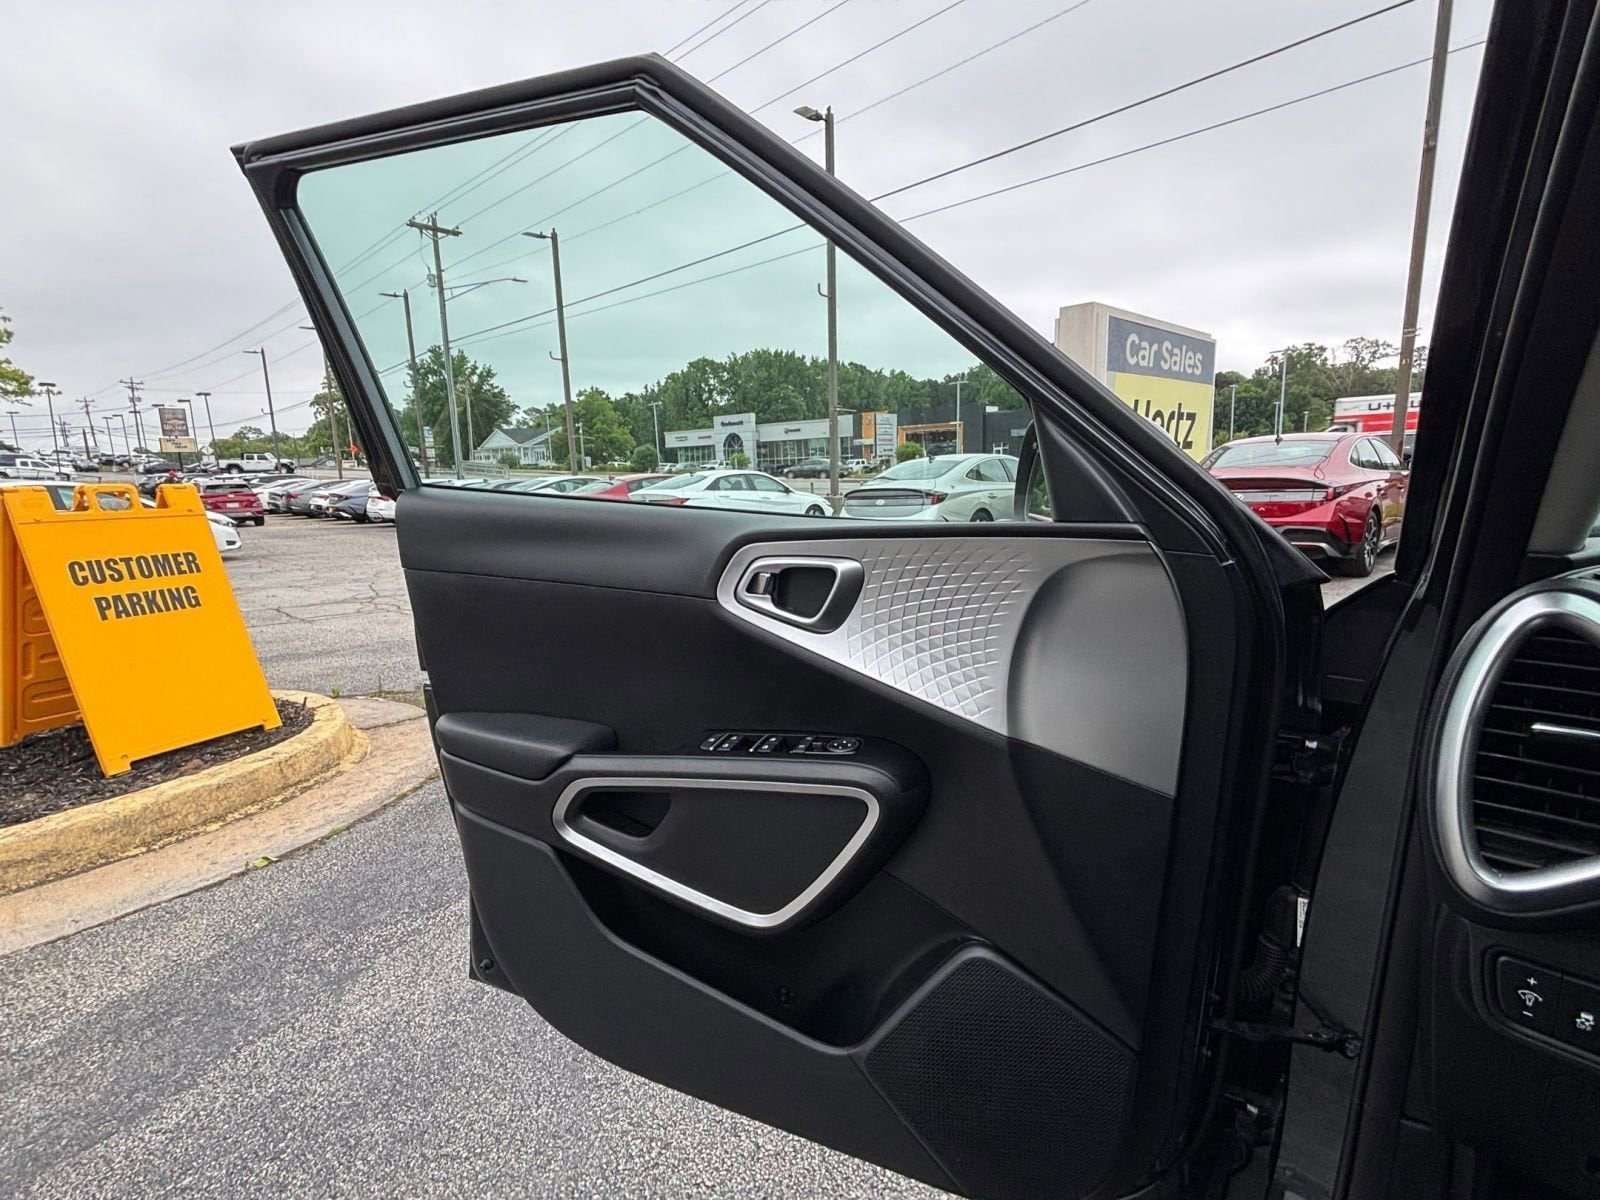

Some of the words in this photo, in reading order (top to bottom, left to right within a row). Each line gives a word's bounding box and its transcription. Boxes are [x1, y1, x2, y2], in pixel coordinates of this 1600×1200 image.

[1125, 333, 1158, 368] Car
[1160, 340, 1203, 375] Sales
[67, 551, 202, 587] CUSTOMER
[93, 585, 202, 622] PARKING
